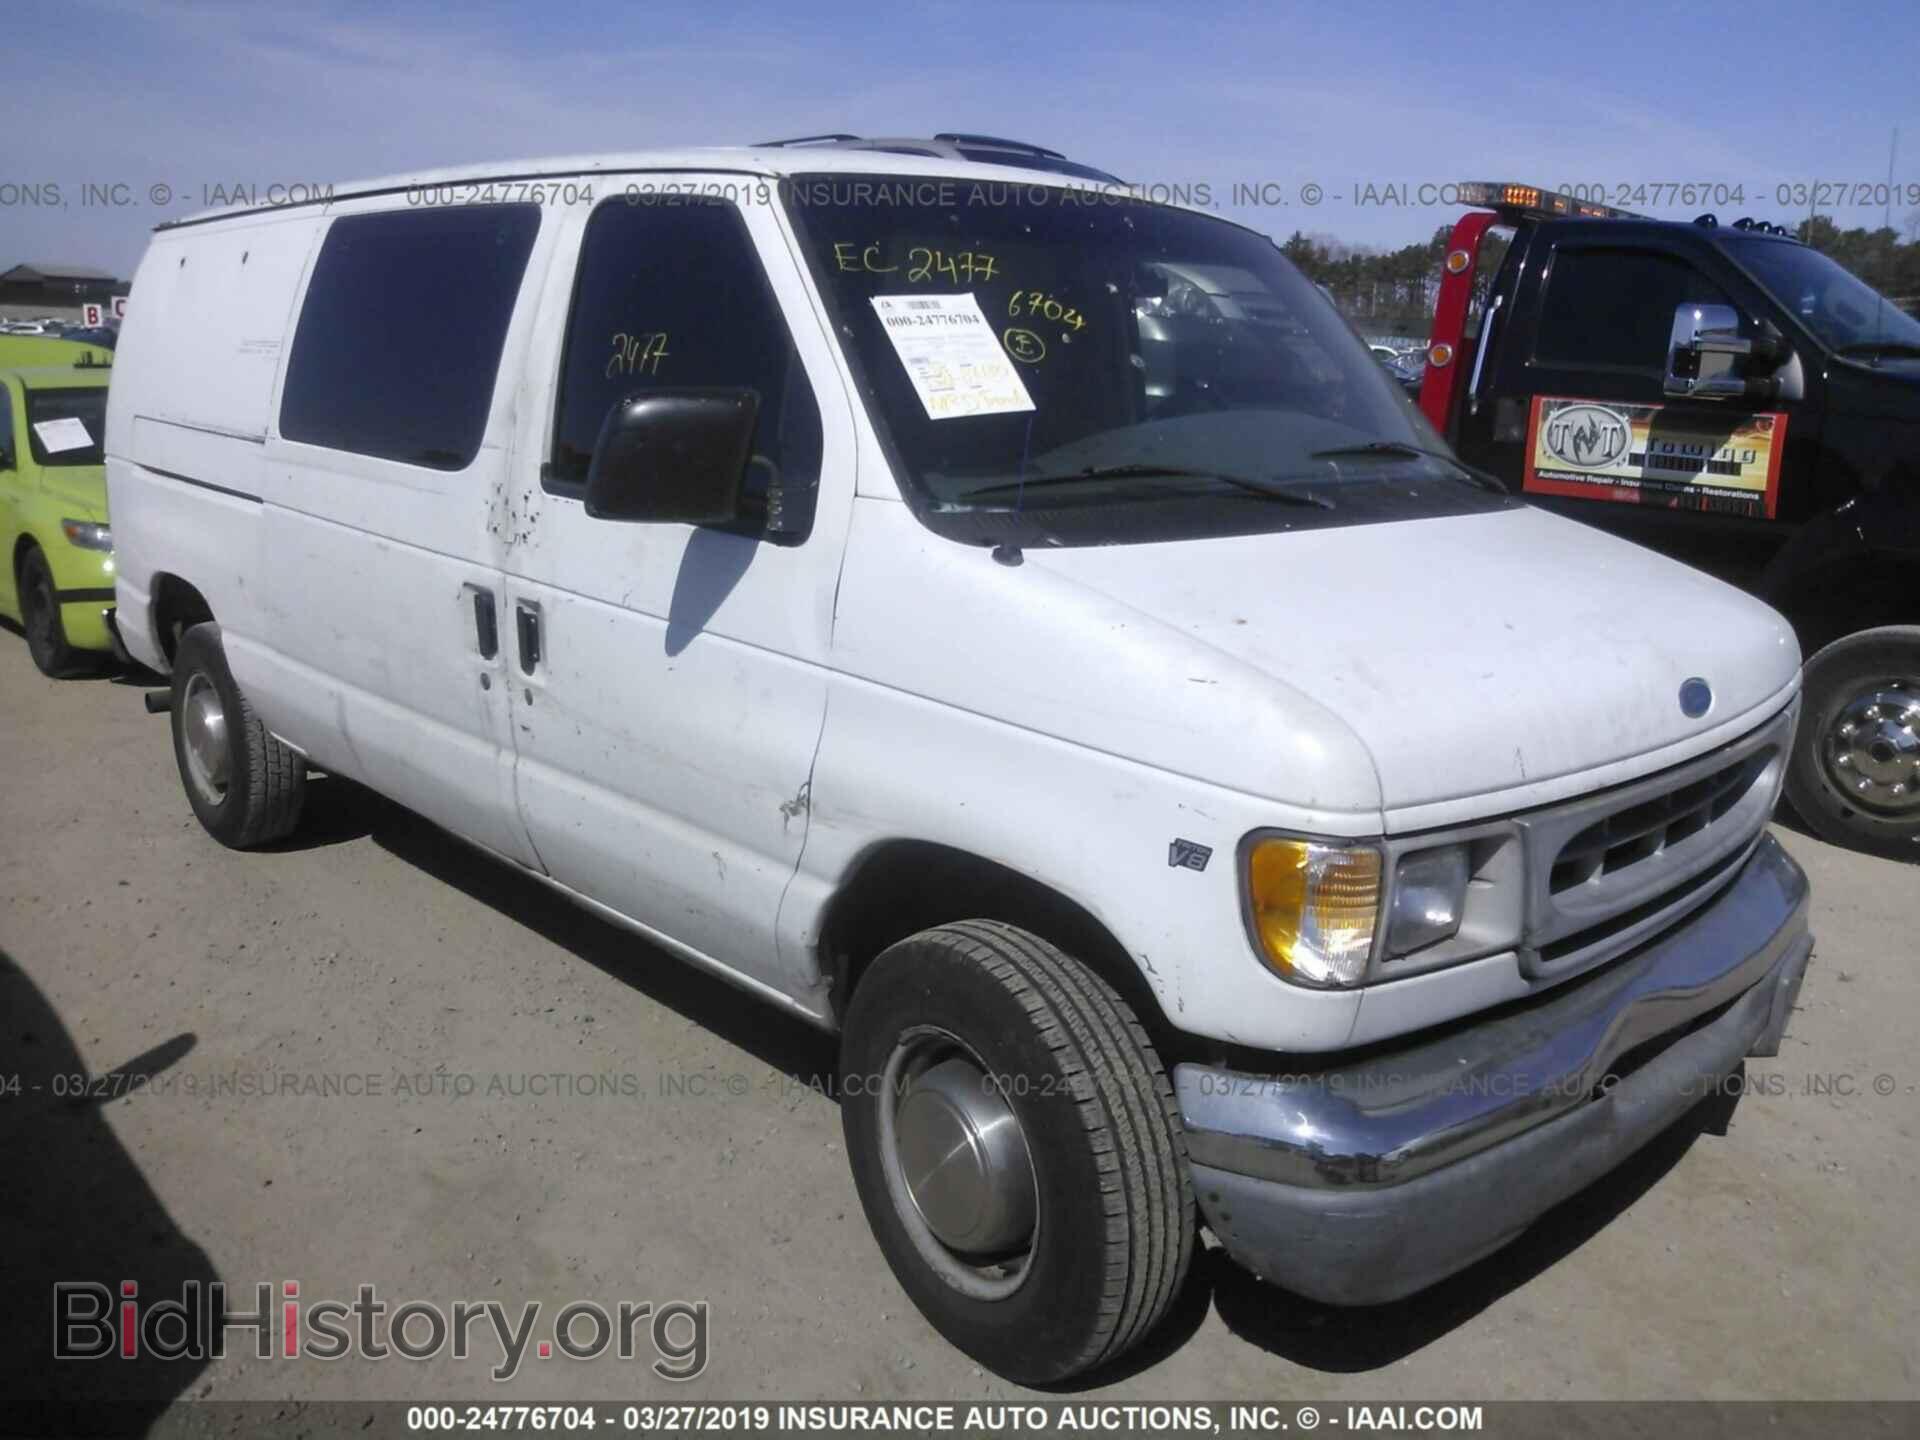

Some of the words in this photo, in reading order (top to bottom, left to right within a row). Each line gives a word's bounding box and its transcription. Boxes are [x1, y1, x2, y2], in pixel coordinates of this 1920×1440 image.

[908, 248, 1000, 284] 2477
[87, 306, 98, 325] B
[115, 299, 126, 318] C
[886, 314, 980, 328] 000-24776704
[1551, 414, 1622, 463] TNT
[1537, 471, 1585, 482] Automotive
[1587, 474, 1614, 486] Repair
[1702, 487, 1760, 500] Restorations
[1168, 838, 1213, 872] V8
